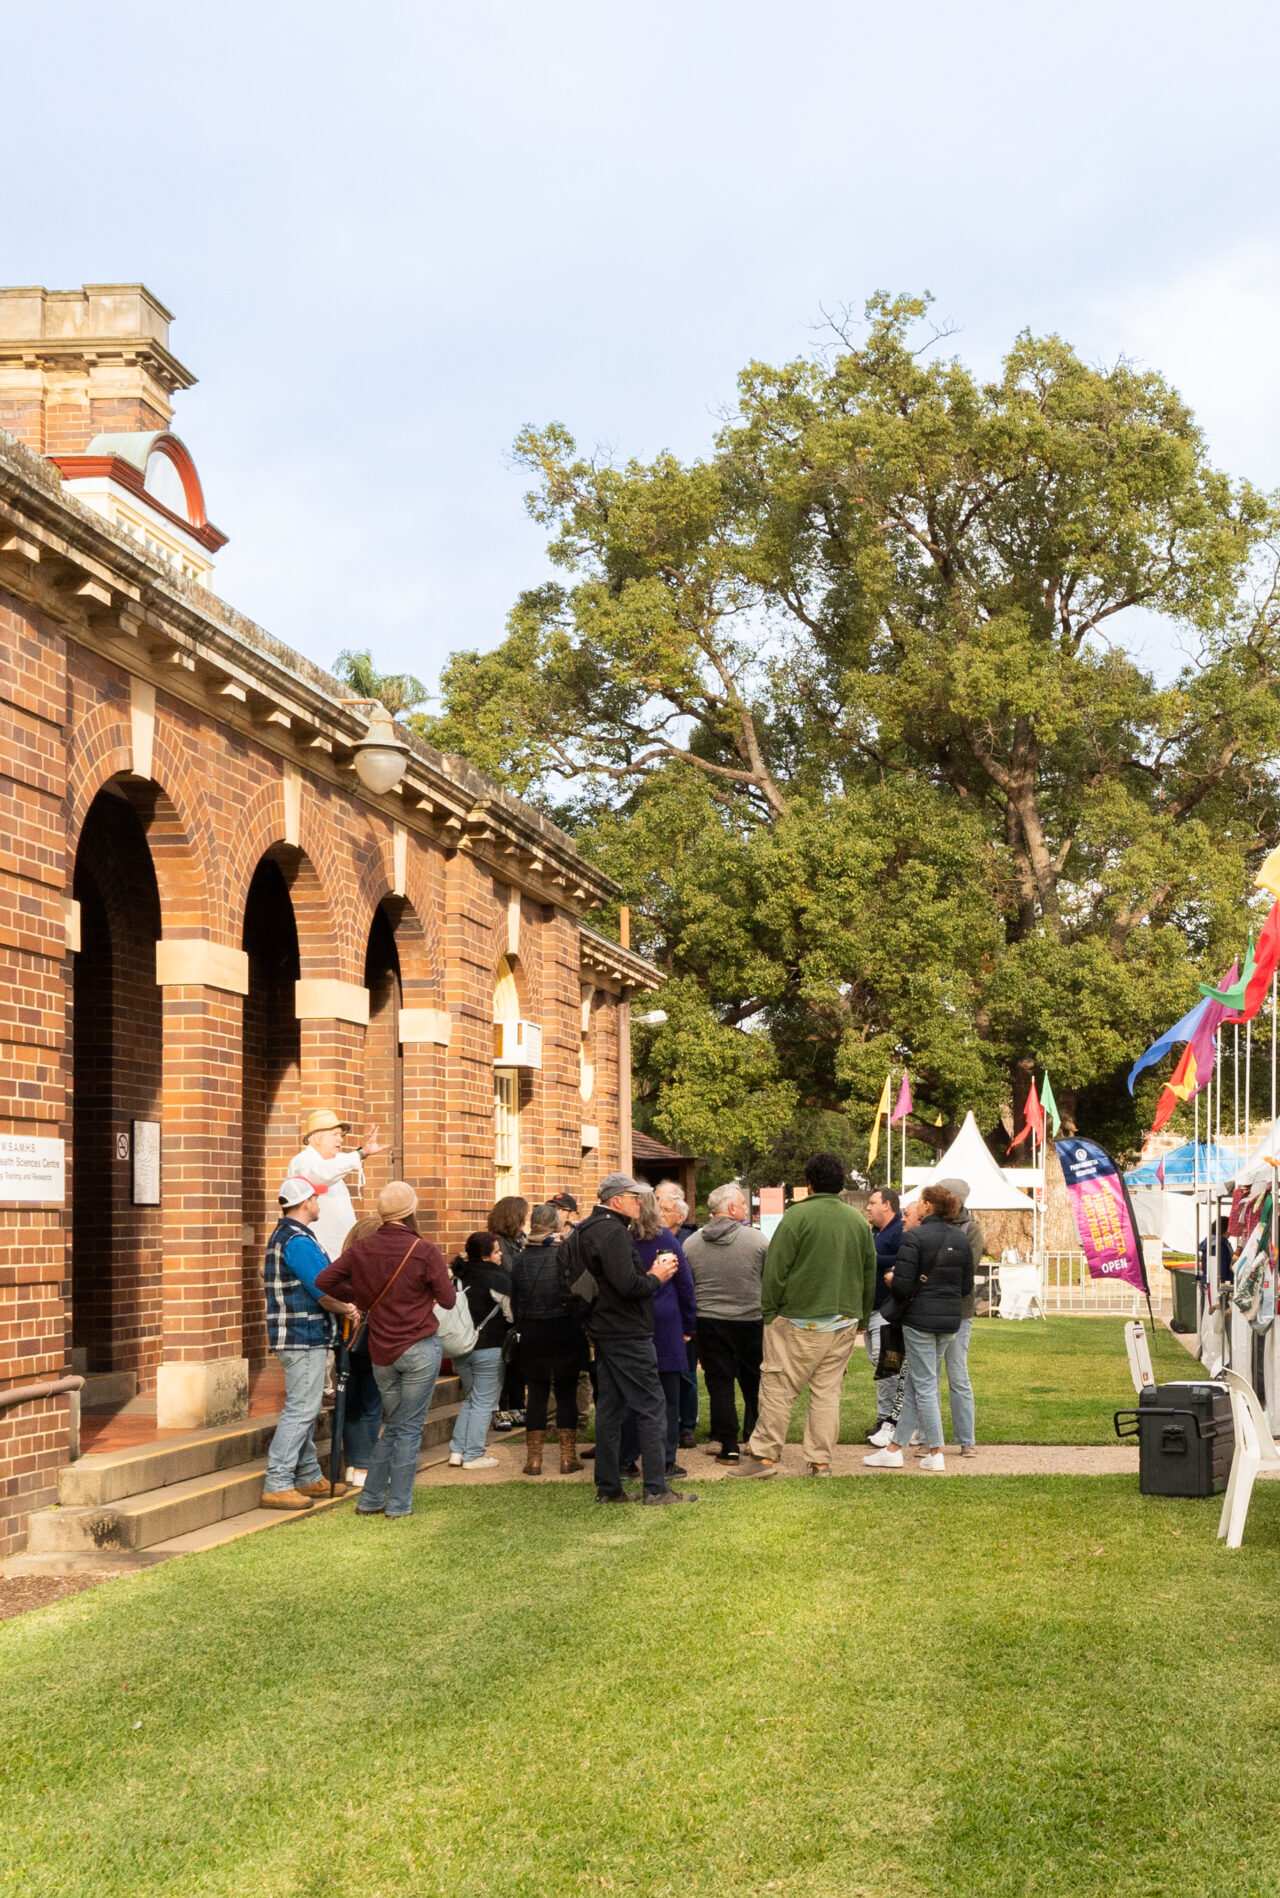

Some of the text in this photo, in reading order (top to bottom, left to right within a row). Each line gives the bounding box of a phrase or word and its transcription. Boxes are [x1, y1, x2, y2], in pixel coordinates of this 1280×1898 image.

[16, 1157, 41, 1168] Sciences
[42, 1158, 61, 1169] Centre
[1081, 1194, 1104, 1252] PARTNERS
[1092, 1193, 1114, 1248] HERITAGE
[1099, 1179, 1127, 1256] PARRAMATTA
[1101, 1257, 1128, 1274] OPEN
